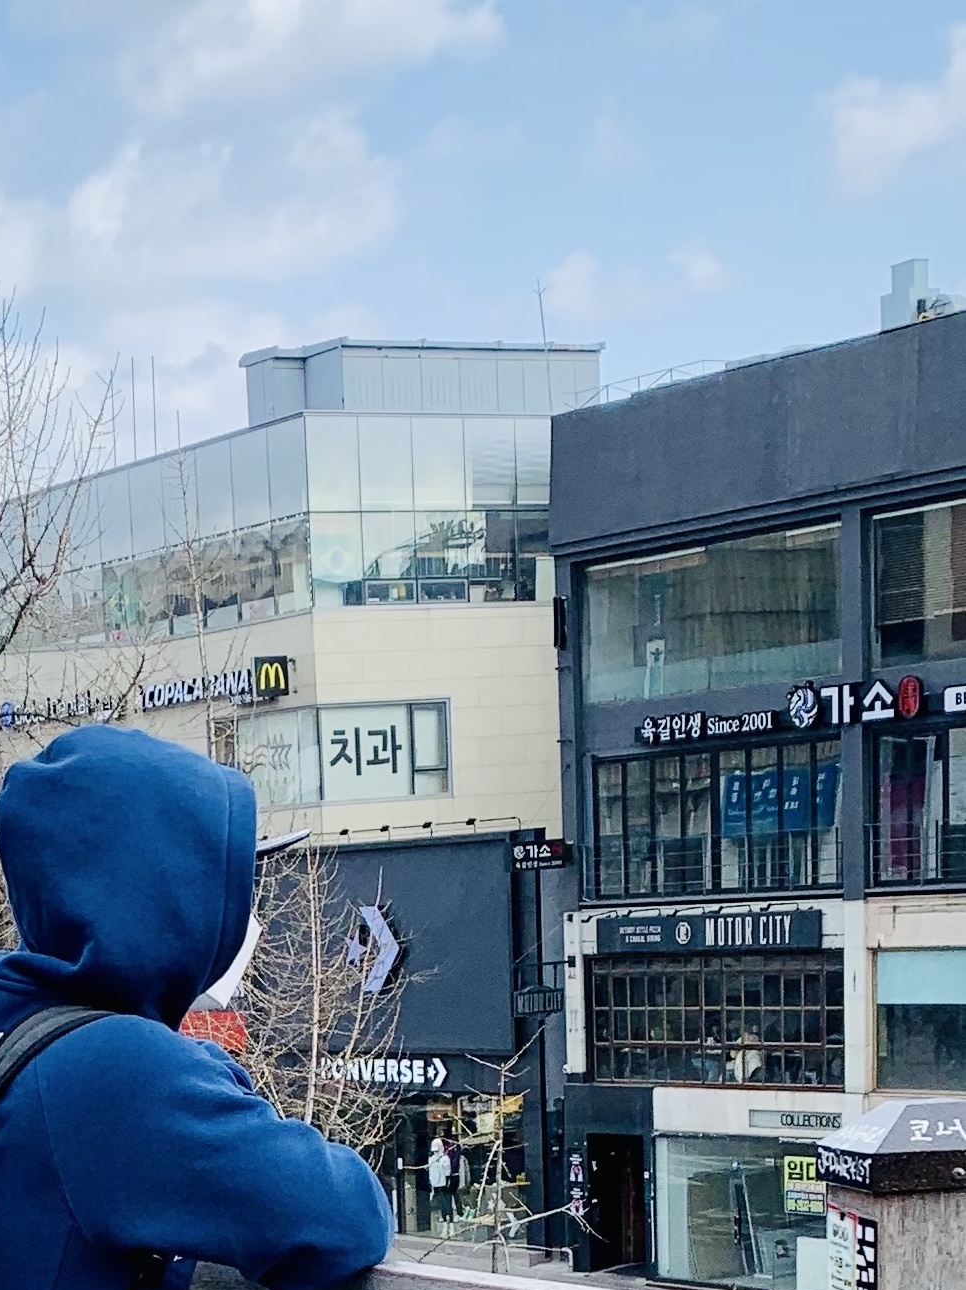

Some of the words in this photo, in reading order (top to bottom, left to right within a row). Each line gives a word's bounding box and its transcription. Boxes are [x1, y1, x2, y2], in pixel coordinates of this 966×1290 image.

[821, 680, 895, 725] 가소
[640, 712, 702, 745] 육길인생
[707, 715, 740, 736] Since
[741, 712, 773, 733] 2001
[329, 724, 403, 776] 치과
[525, 845, 552, 859] 가소
[705, 916, 753, 946] MOTOR
[759, 915, 791, 945] CITY
[546, 991, 562, 1011] CITY
[320, 1058, 425, 1084] CONVERSE
[780, 1113, 841, 1129] COLLECTIONS
